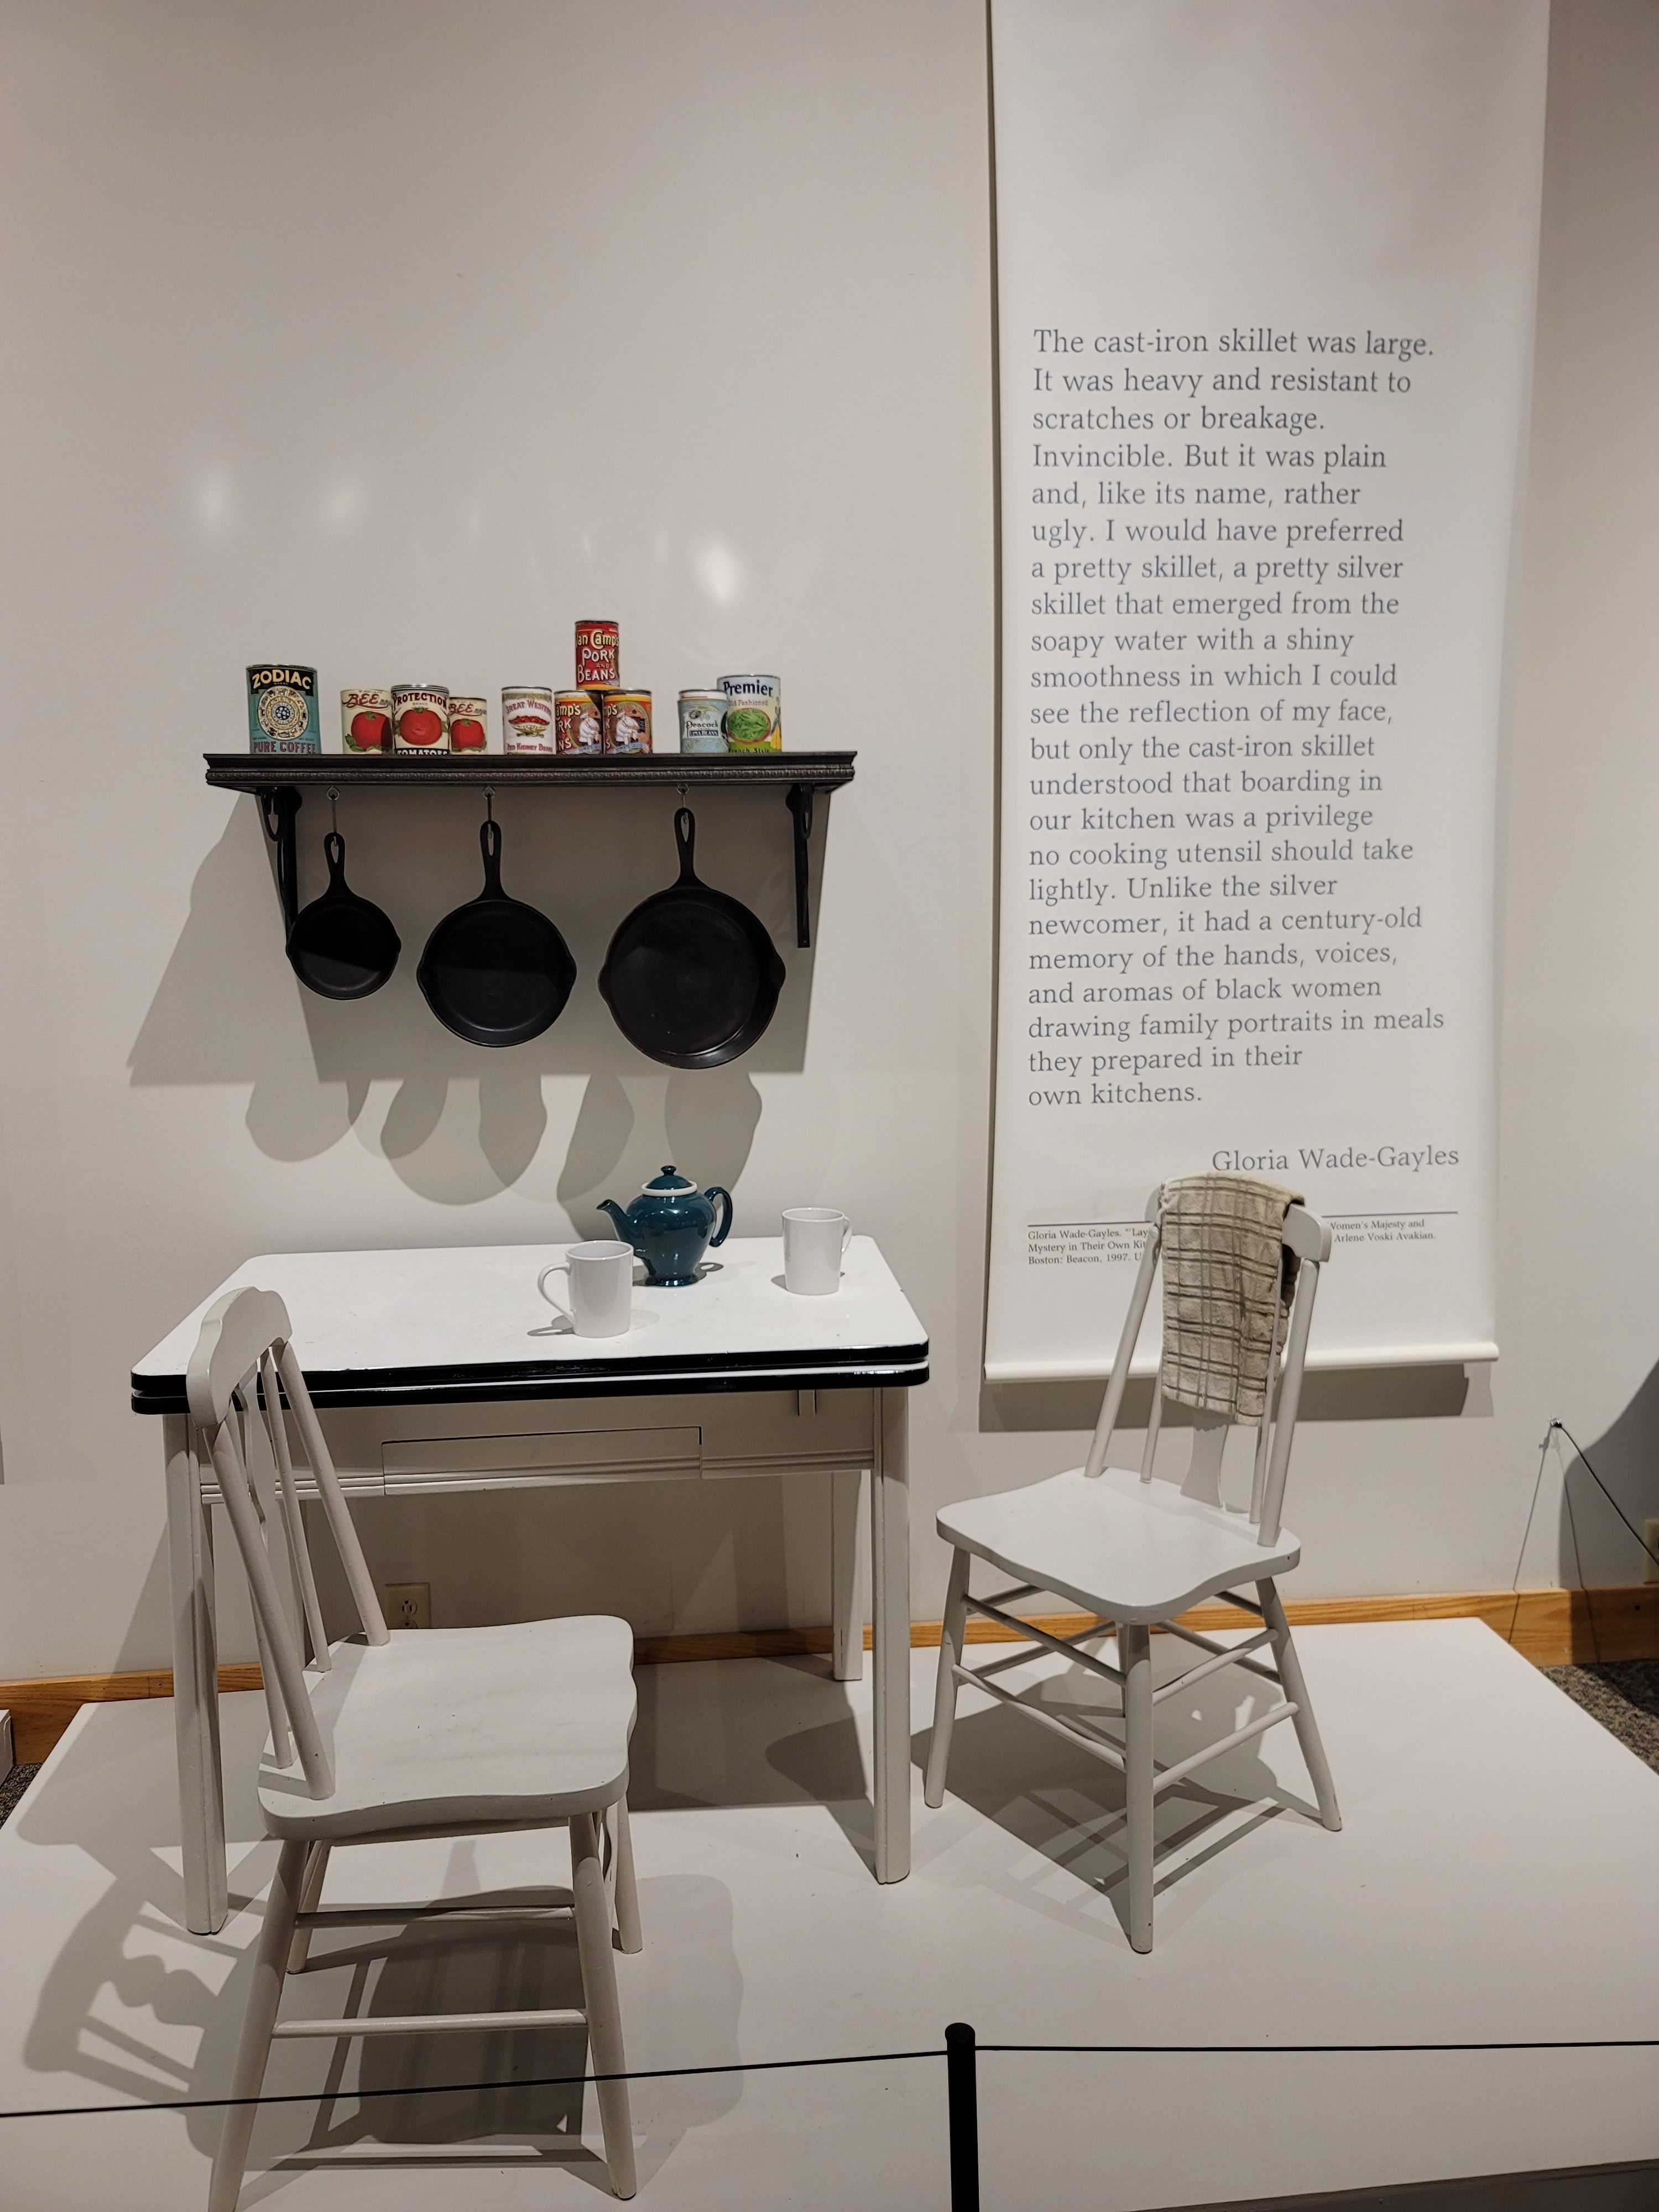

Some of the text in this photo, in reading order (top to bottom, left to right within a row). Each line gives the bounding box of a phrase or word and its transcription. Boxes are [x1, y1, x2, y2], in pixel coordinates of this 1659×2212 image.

[1033, 327, 1434, 363] The cast-iron skillet was large.
[1034, 366, 1411, 399] It was heavy and resistant to
[1032, 404, 1324, 437] scratches or breakage.
[1033, 443, 1387, 475] Invincible. But it was plain
[1032, 481, 1361, 509] and, like its name, rather
[1031, 517, 1404, 549] ugly. I would have preferred
[1031, 554, 1404, 586] a pretty skillet, a pretty silver
[1031, 591, 1399, 622] skillet that emerged from the
[582, 648, 615, 666] PORK
[1031, 627, 1354, 659] soapy water with a shiny
[252, 670, 311, 689] ZODIAC
[578, 665, 615, 683] BEANS
[723, 680, 773, 697] Premier
[1031, 662, 1397, 688] smoothness in which I could
[342, 693, 380, 708] BEE
[393, 692, 447, 711] PROTECTION
[1030, 698, 1391, 728] see the reflection of my face,
[253, 742, 316, 754] PURE COFFEE
[1030, 734, 1375, 766] but only the cast-iron skillet
[1029, 769, 1383, 798] understood that boarding in
[1030, 804, 1373, 834] our kitchen was a privilege
[1029, 838, 1413, 870] no cooking utensil should take
[1029, 873, 1338, 907] lightly. Unlike the silver
[1029, 906, 1422, 937] newcomer, it had a century-old
[1029, 941, 1396, 974] memory of the hands, voices,
[1028, 977, 1382, 1004] and aromas of black women
[1029, 1007, 1444, 1042] drawing family portraits in meals
[1028, 1044, 1303, 1078] they prepared in their
[1029, 1081, 1202, 1106] own kitchens.
[1212, 1144, 1459, 1172] Gloria Wade-Gayles
[1028, 1231, 1056, 1240] Gloria
[1060, 1229, 1121, 1240] Wade-Gayles.
[1371, 1220, 1405, 1230] Majesty
[1408, 1219, 1425, 1228] and
[1029, 1244, 1066, 1254] Mystery
[1068, 1243, 1077, 1251] in
[1078, 1241, 1104, 1250] Their
[1108, 1241, 1130, 1249] Own
[1334, 1233, 1365, 1243] Arlene
[1367, 1232, 1393, 1241] Voski
[1396, 1230, 1436, 1241] Avakian.
[1029, 1256, 1063, 1265] Boston:
[1066, 1254, 1102, 1264] Beacon,
[1107, 1253, 1130, 1262] 1997.
